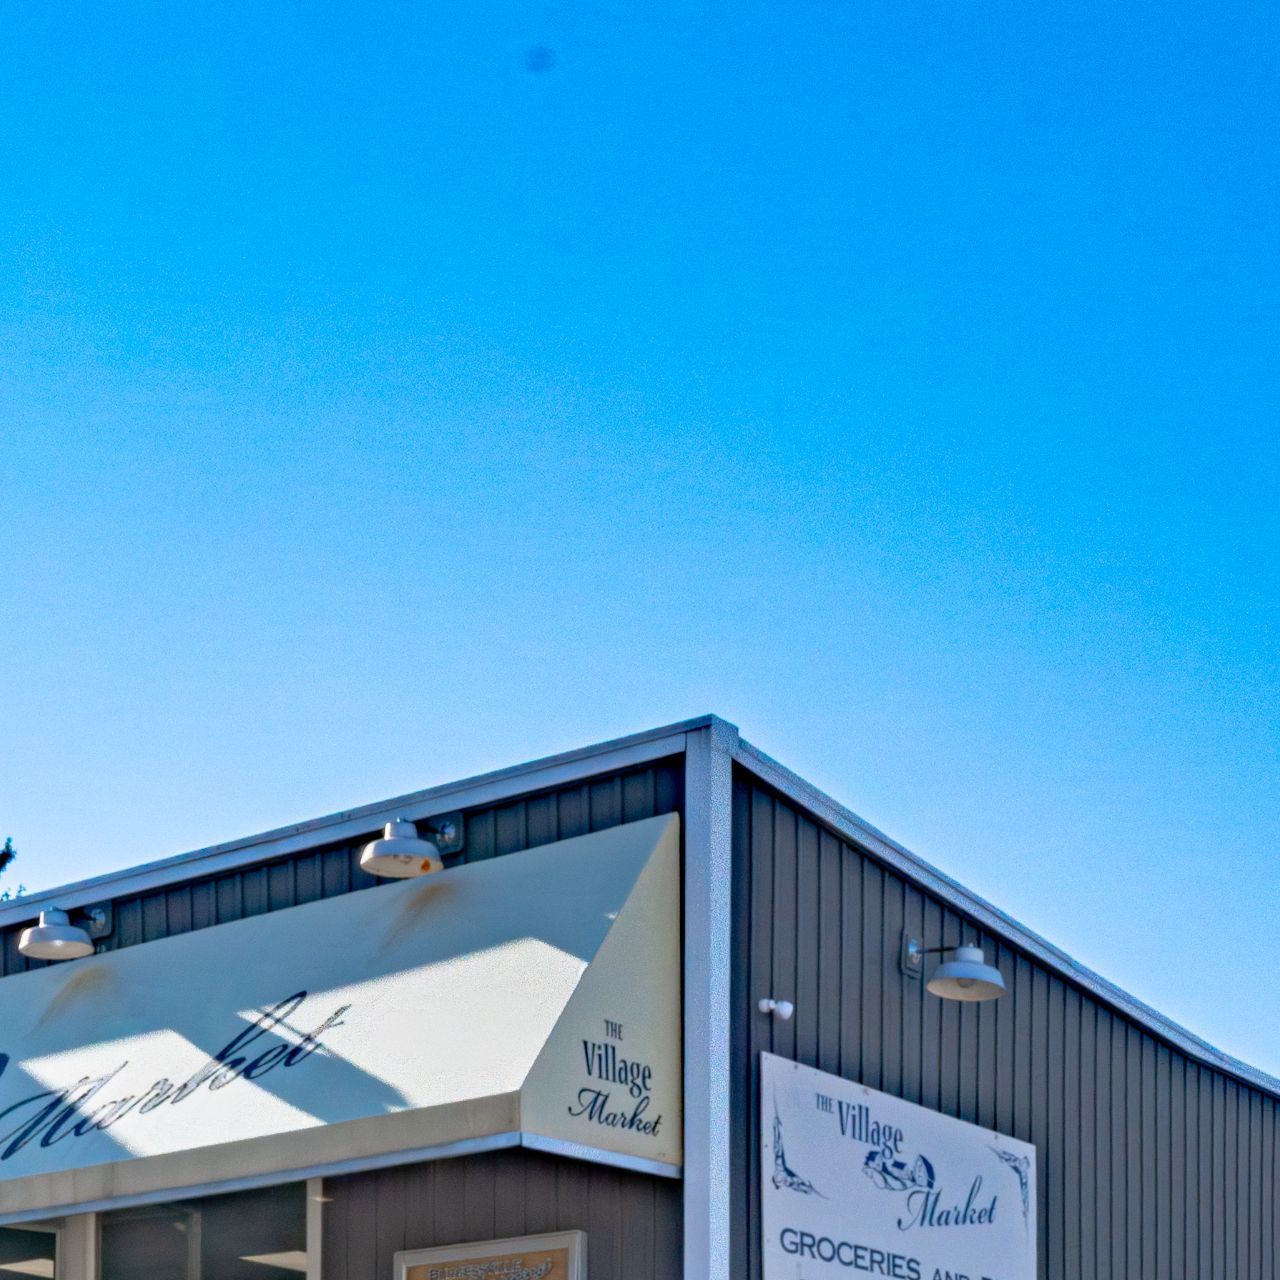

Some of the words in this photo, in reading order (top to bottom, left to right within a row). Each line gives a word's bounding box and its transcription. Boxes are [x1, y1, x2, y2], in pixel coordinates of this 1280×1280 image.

[604, 1019, 623, 1040] THE
[582, 1040, 651, 1098] Village
[568, 1088, 662, 1137] Market
[816, 1093, 834, 1114] THE
[837, 1100, 904, 1159] Village
[897, 1175, 997, 1231] Market
